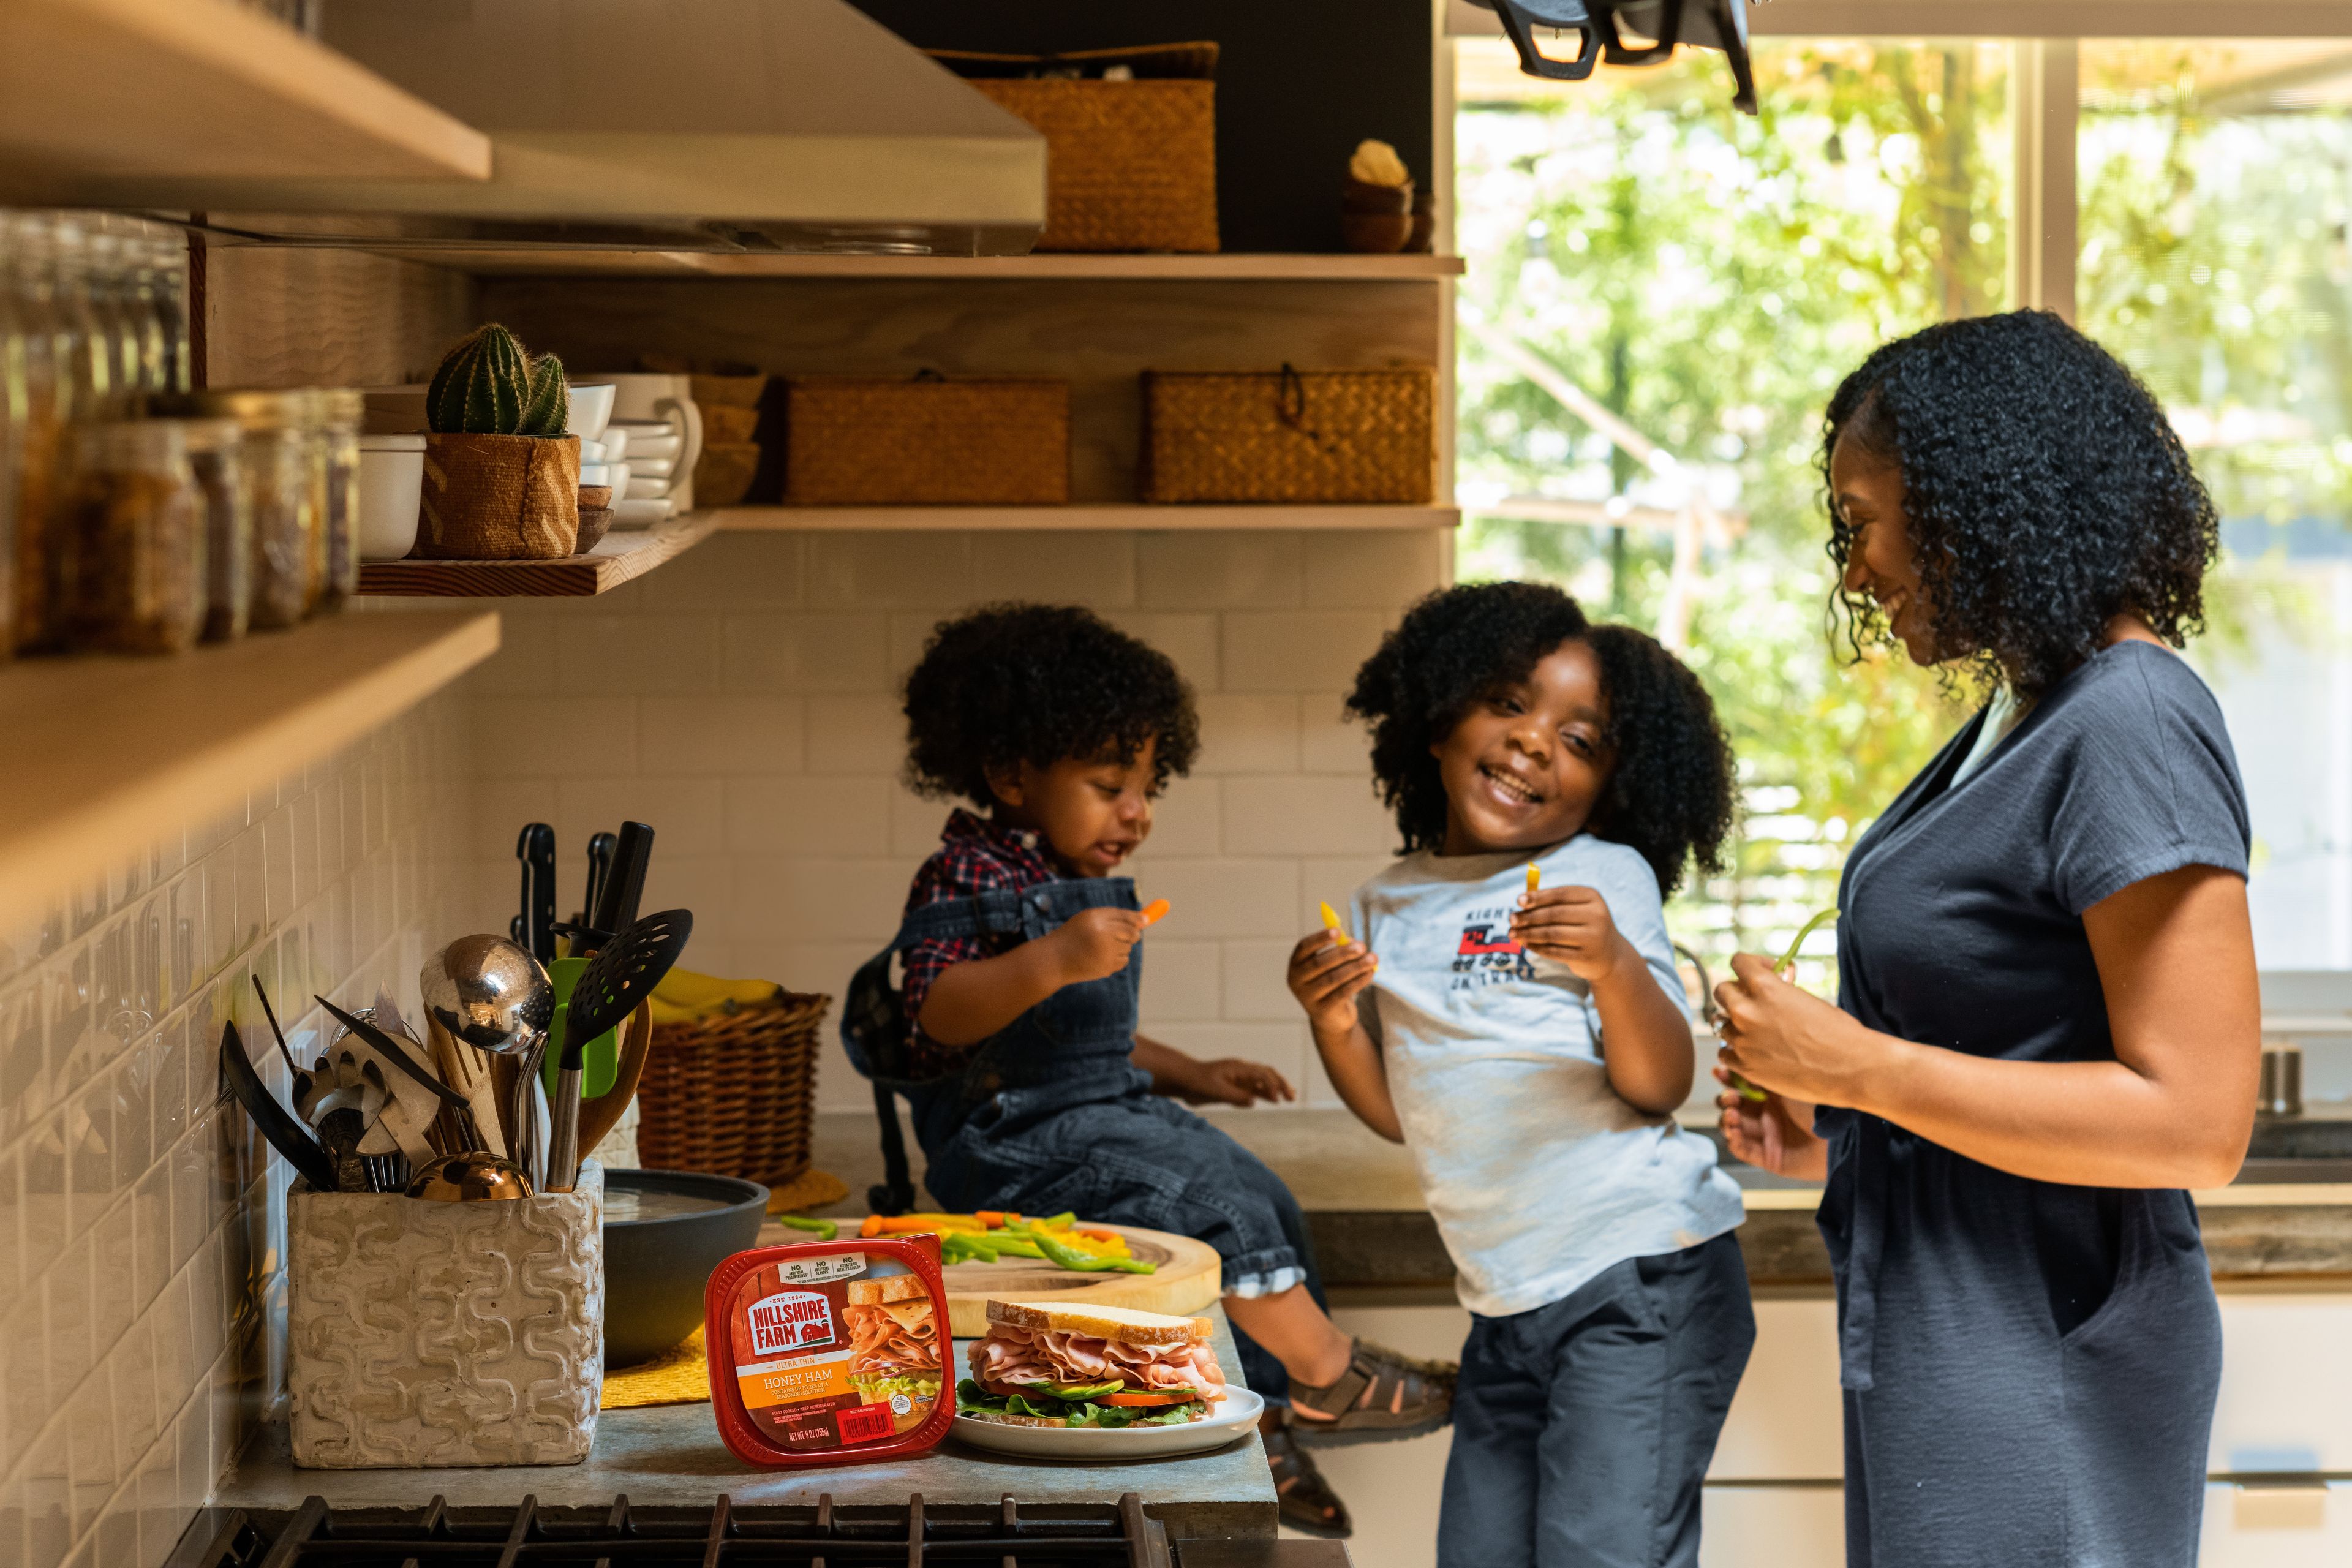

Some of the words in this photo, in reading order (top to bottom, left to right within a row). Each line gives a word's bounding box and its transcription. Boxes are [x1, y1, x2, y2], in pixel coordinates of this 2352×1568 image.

[753, 1298, 827, 1329] HILLSHIRE
[756, 1324, 797, 1349] FARM
[776, 1360, 797, 1369] ULTRA
[799, 1357, 815, 1366] THIN
[764, 1373, 802, 1390] HONEY
[805, 1368, 833, 1383] HAM
[777, 1391, 802, 1400] SEASONING
[802, 1387, 826, 1396] SOLUTION
[789, 1432, 797, 1441] NET
[797, 1431, 806, 1440] WT.
[806, 1430, 809, 1439] 9
[809, 1429, 815, 1438] OZ
[815, 1427, 829, 1439] (255g)
